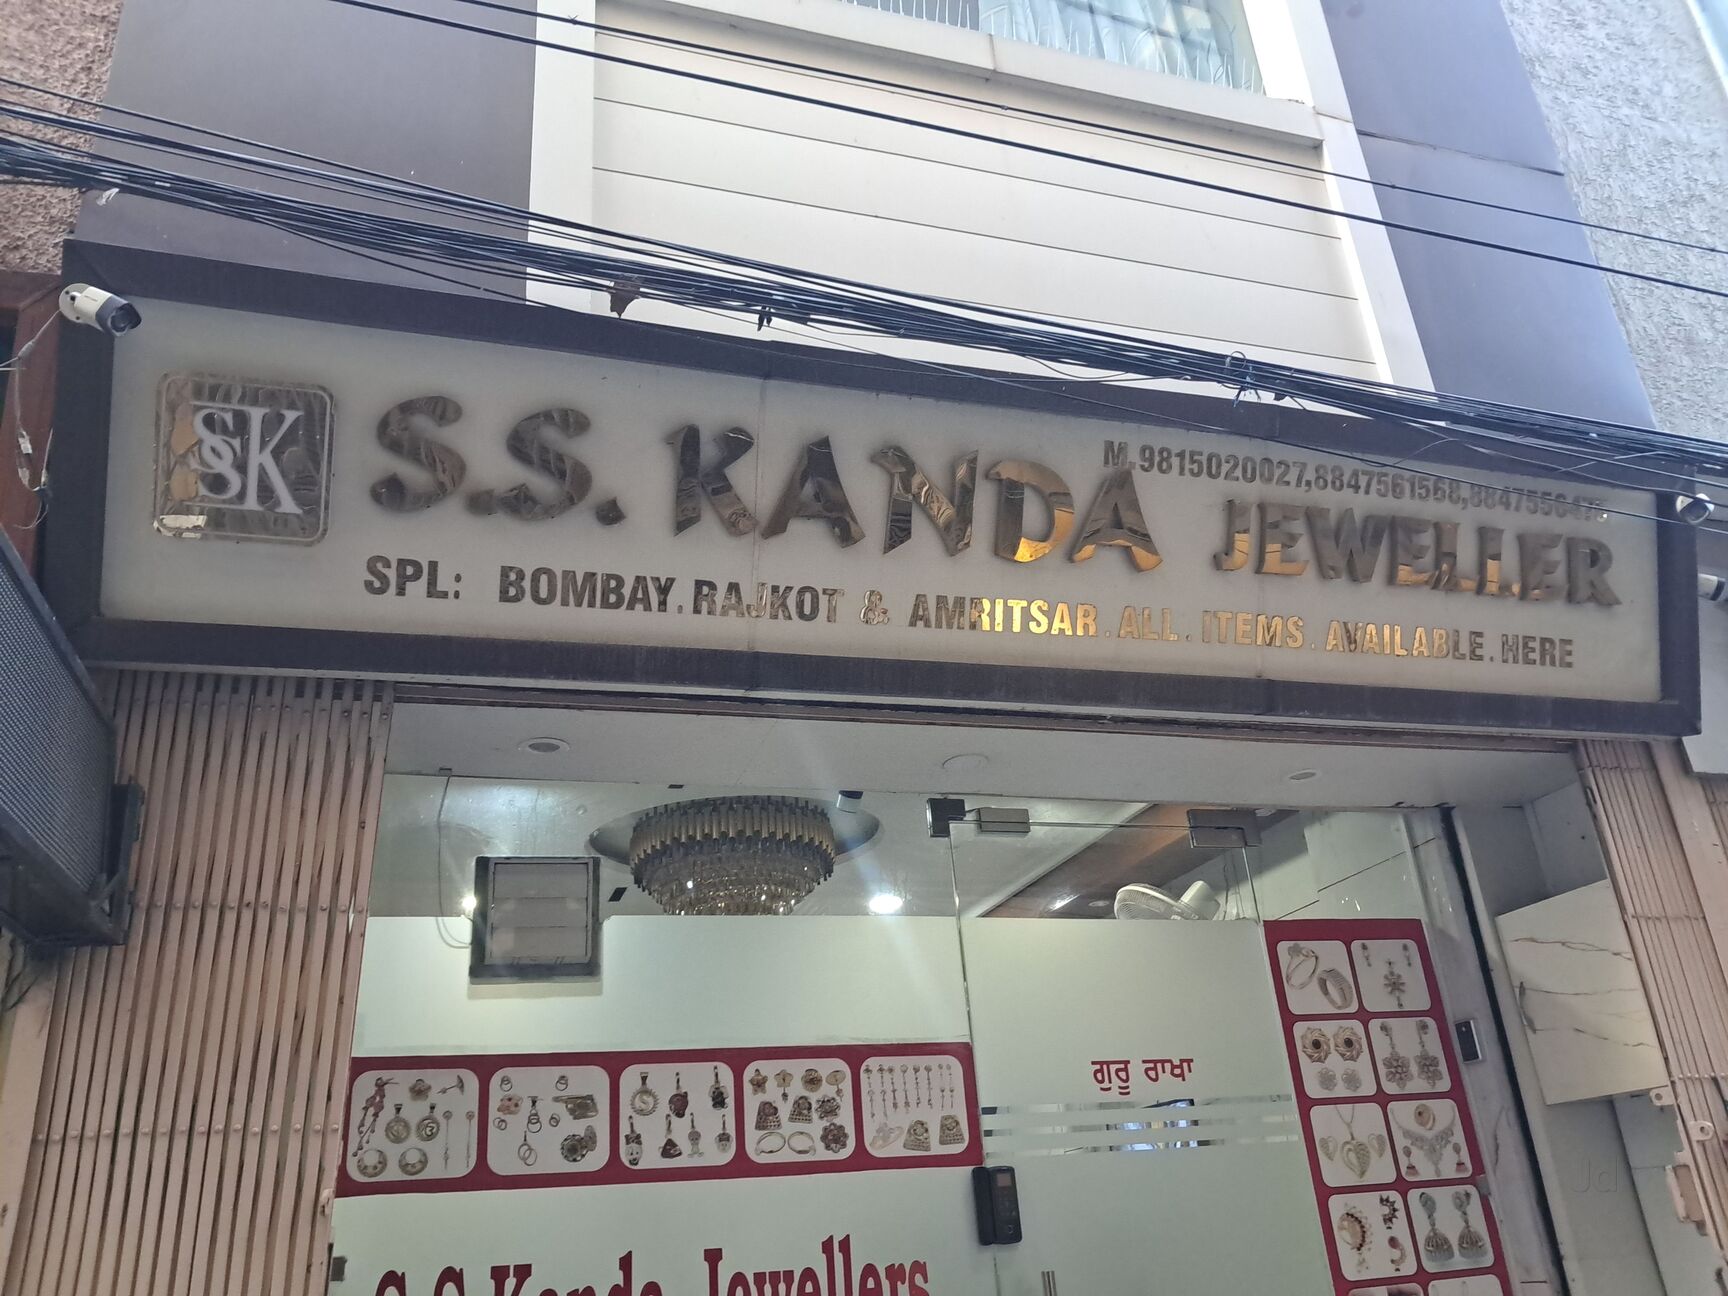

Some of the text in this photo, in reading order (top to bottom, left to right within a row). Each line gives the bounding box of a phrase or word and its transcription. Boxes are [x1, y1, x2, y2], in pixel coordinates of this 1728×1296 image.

[666, 422, 1164, 573] KANDA
[1212, 498, 1623, 606] JEWELLER
[364, 555, 463, 600] SPL:
[858, 588, 891, 626] &
[1501, 632, 1574, 669] HERE
[1090, 1058, 1194, 1096] ਗੁਰੂ ਰਾਖਾ
